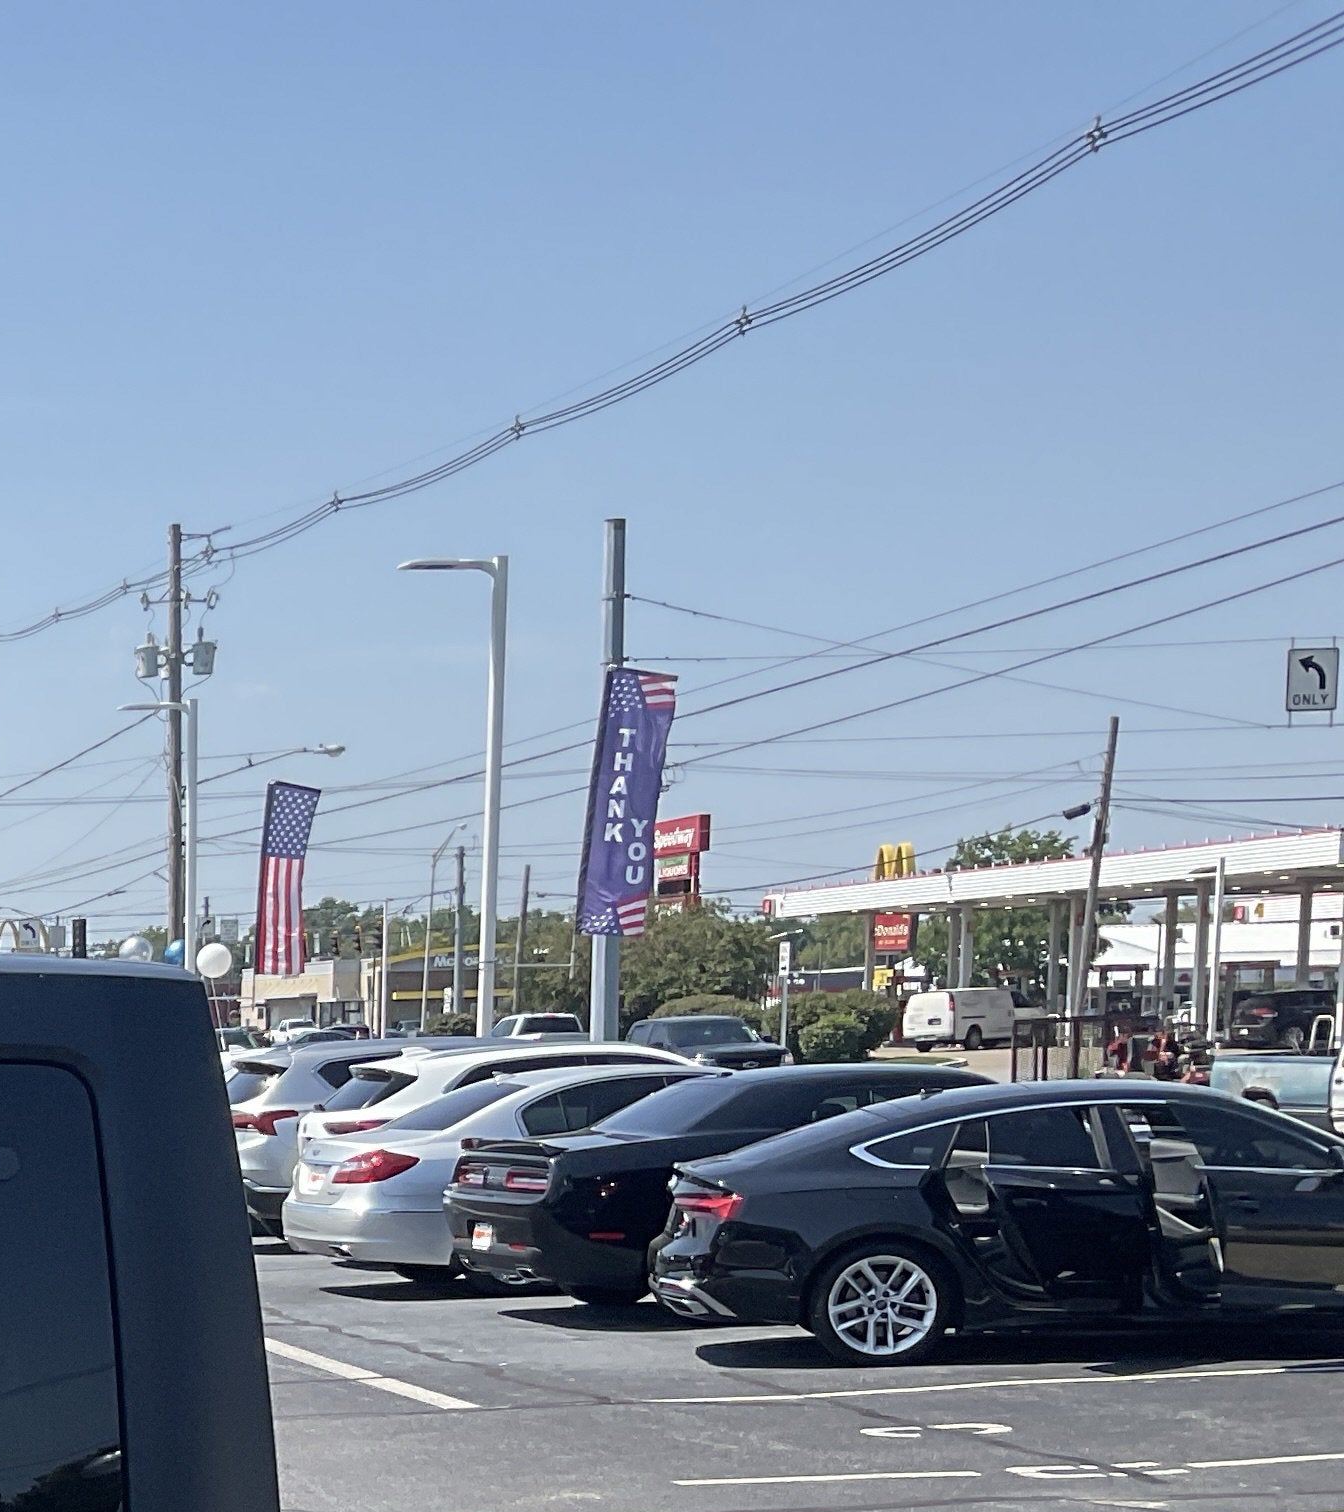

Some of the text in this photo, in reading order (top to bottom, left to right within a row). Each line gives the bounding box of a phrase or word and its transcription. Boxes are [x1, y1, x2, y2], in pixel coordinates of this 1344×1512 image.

[1292, 693, 1329, 706] ONLY
[604, 728, 648, 885] THANK YOU
